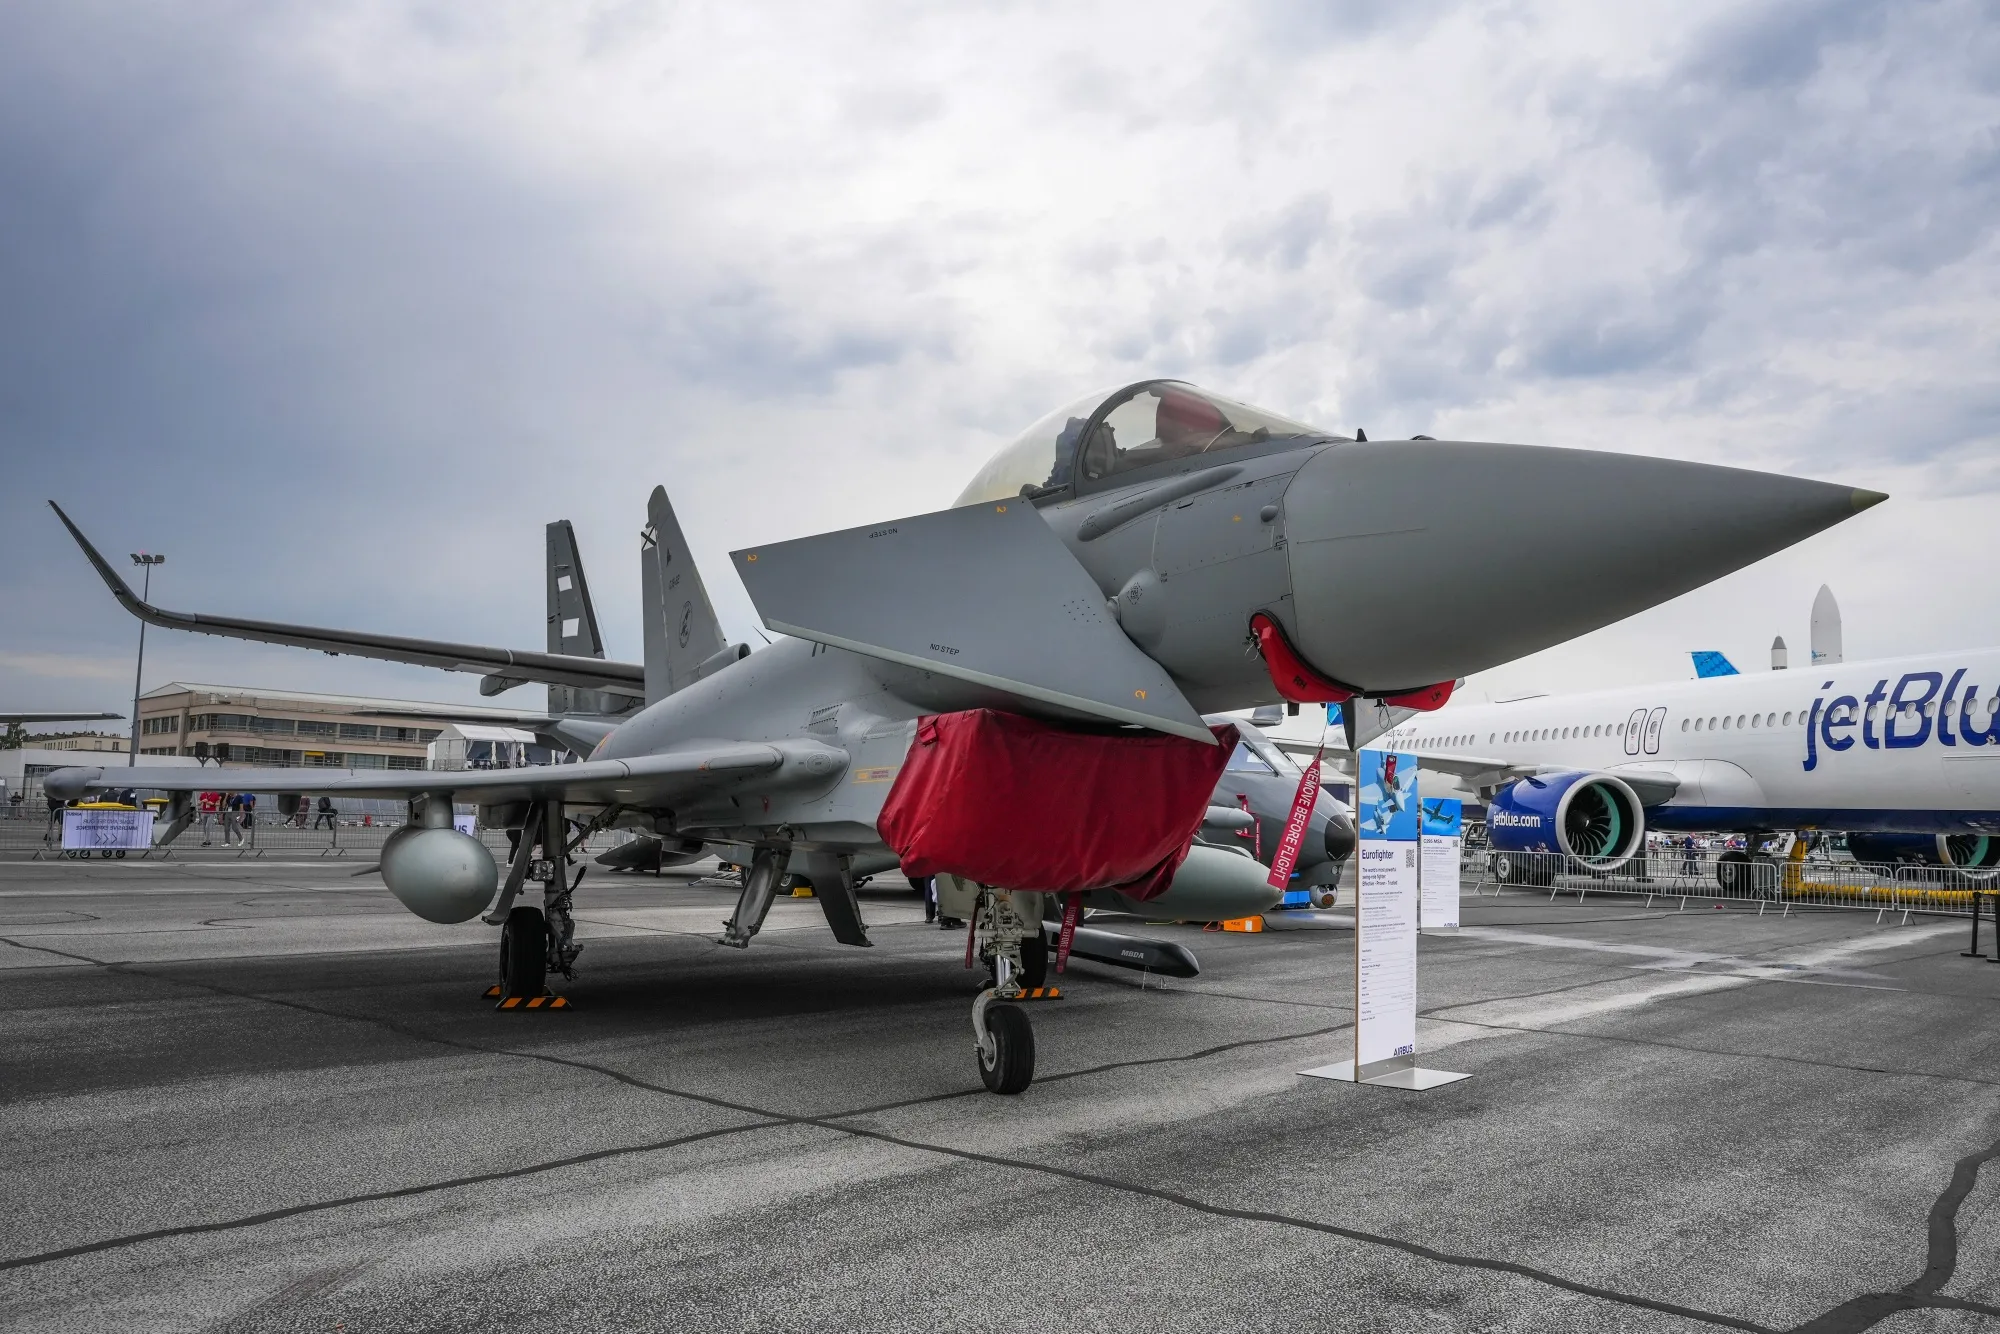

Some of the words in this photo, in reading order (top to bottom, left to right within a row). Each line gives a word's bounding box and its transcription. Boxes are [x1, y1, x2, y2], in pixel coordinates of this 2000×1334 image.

[868, 529, 888, 539] STEP
[929, 643, 940, 651] NO
[940, 645, 960, 656] STEP
[1298, 767, 1320, 807] REMOVE
[1285, 805, 1309, 847] BEFORE
[1493, 811, 1541, 829] jetblue.com
[1362, 849, 1394, 861] Eurofighter
[1273, 843, 1295, 881] FLIGHT
[1120, 949, 1145, 959] MBDA
[1393, 1044, 1413, 1057] AIRBUS
